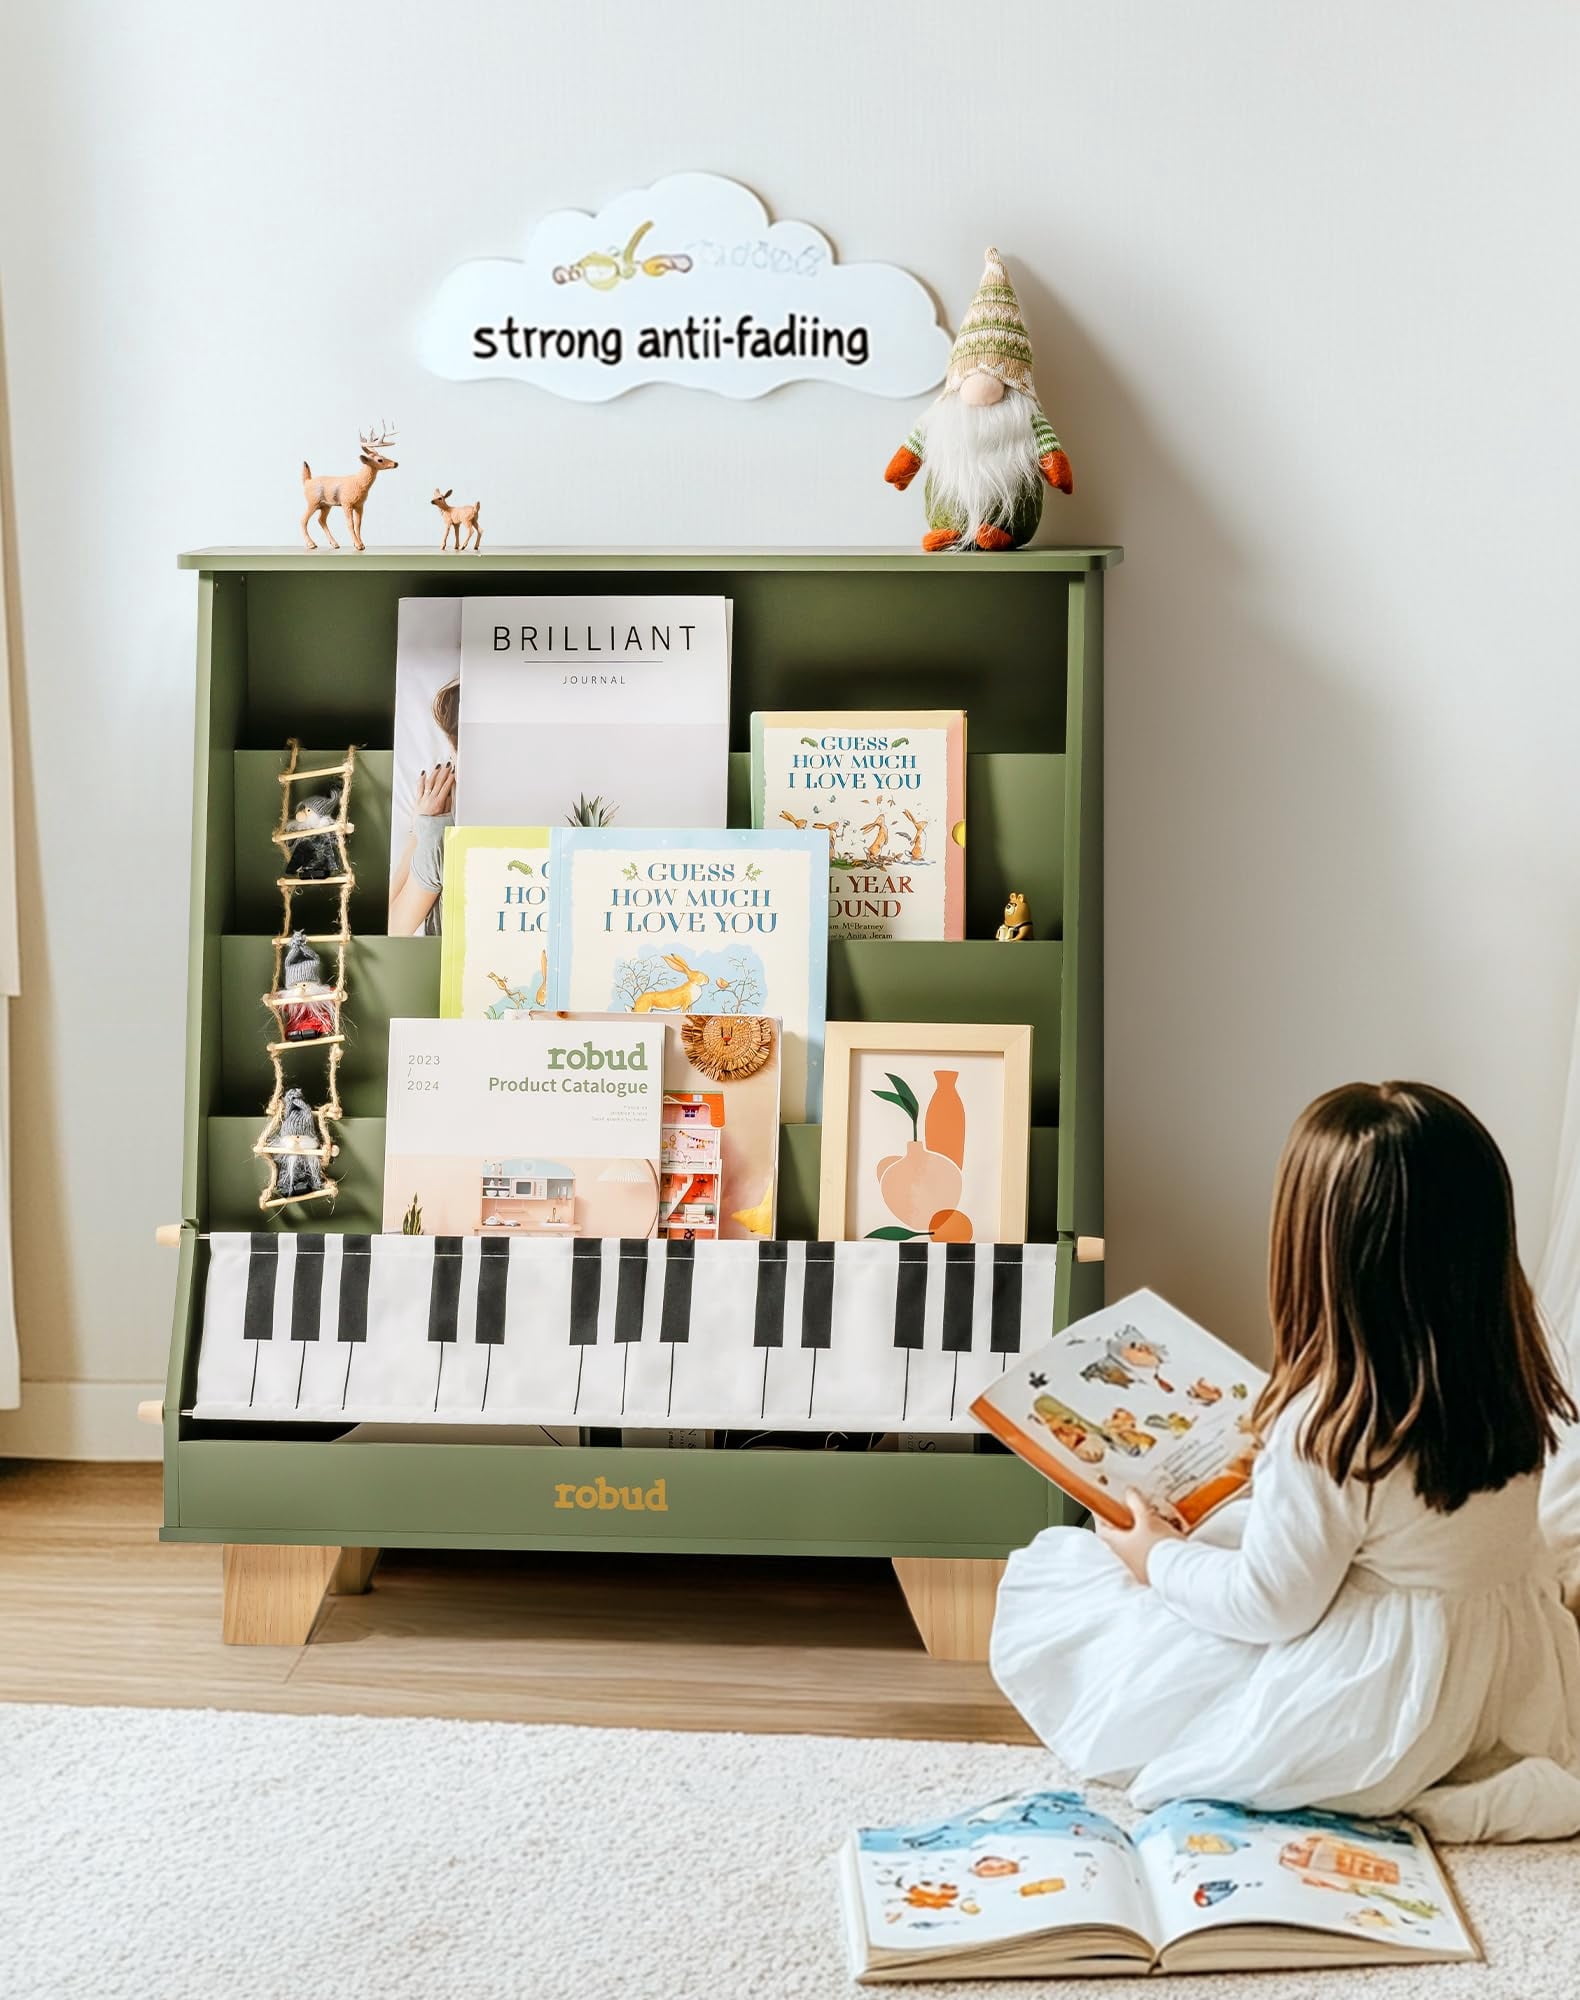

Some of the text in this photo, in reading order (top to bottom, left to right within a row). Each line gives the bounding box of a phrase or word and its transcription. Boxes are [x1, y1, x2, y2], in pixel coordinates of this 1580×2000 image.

[473, 314, 869, 366] strrong antii-fadiing
[493, 625, 696, 651] BRILLIANT
[562, 675, 626, 685] JOURNAL
[821, 736, 888, 751] GUESS
[792, 754, 916, 769] HOW MUCH
[787, 772, 921, 790] I LOVE YOU
[647, 862, 735, 882] GUESS
[846, 875, 914, 894] YEAR
[504, 886, 550, 905] HO
[611, 888, 771, 908] HOW MUCH
[496, 911, 506, 932] I
[603, 910, 779, 934] I LOVE YOU
[846, 931, 867, 940] Anita
[869, 931, 893, 939] Jeram
[408, 1055, 440, 1065] 2023
[547, 1041, 649, 1071] robud
[407, 1080, 440, 1091] 2024
[489, 1076, 649, 1098] Product Catalogue
[554, 1476, 669, 1511] robud
